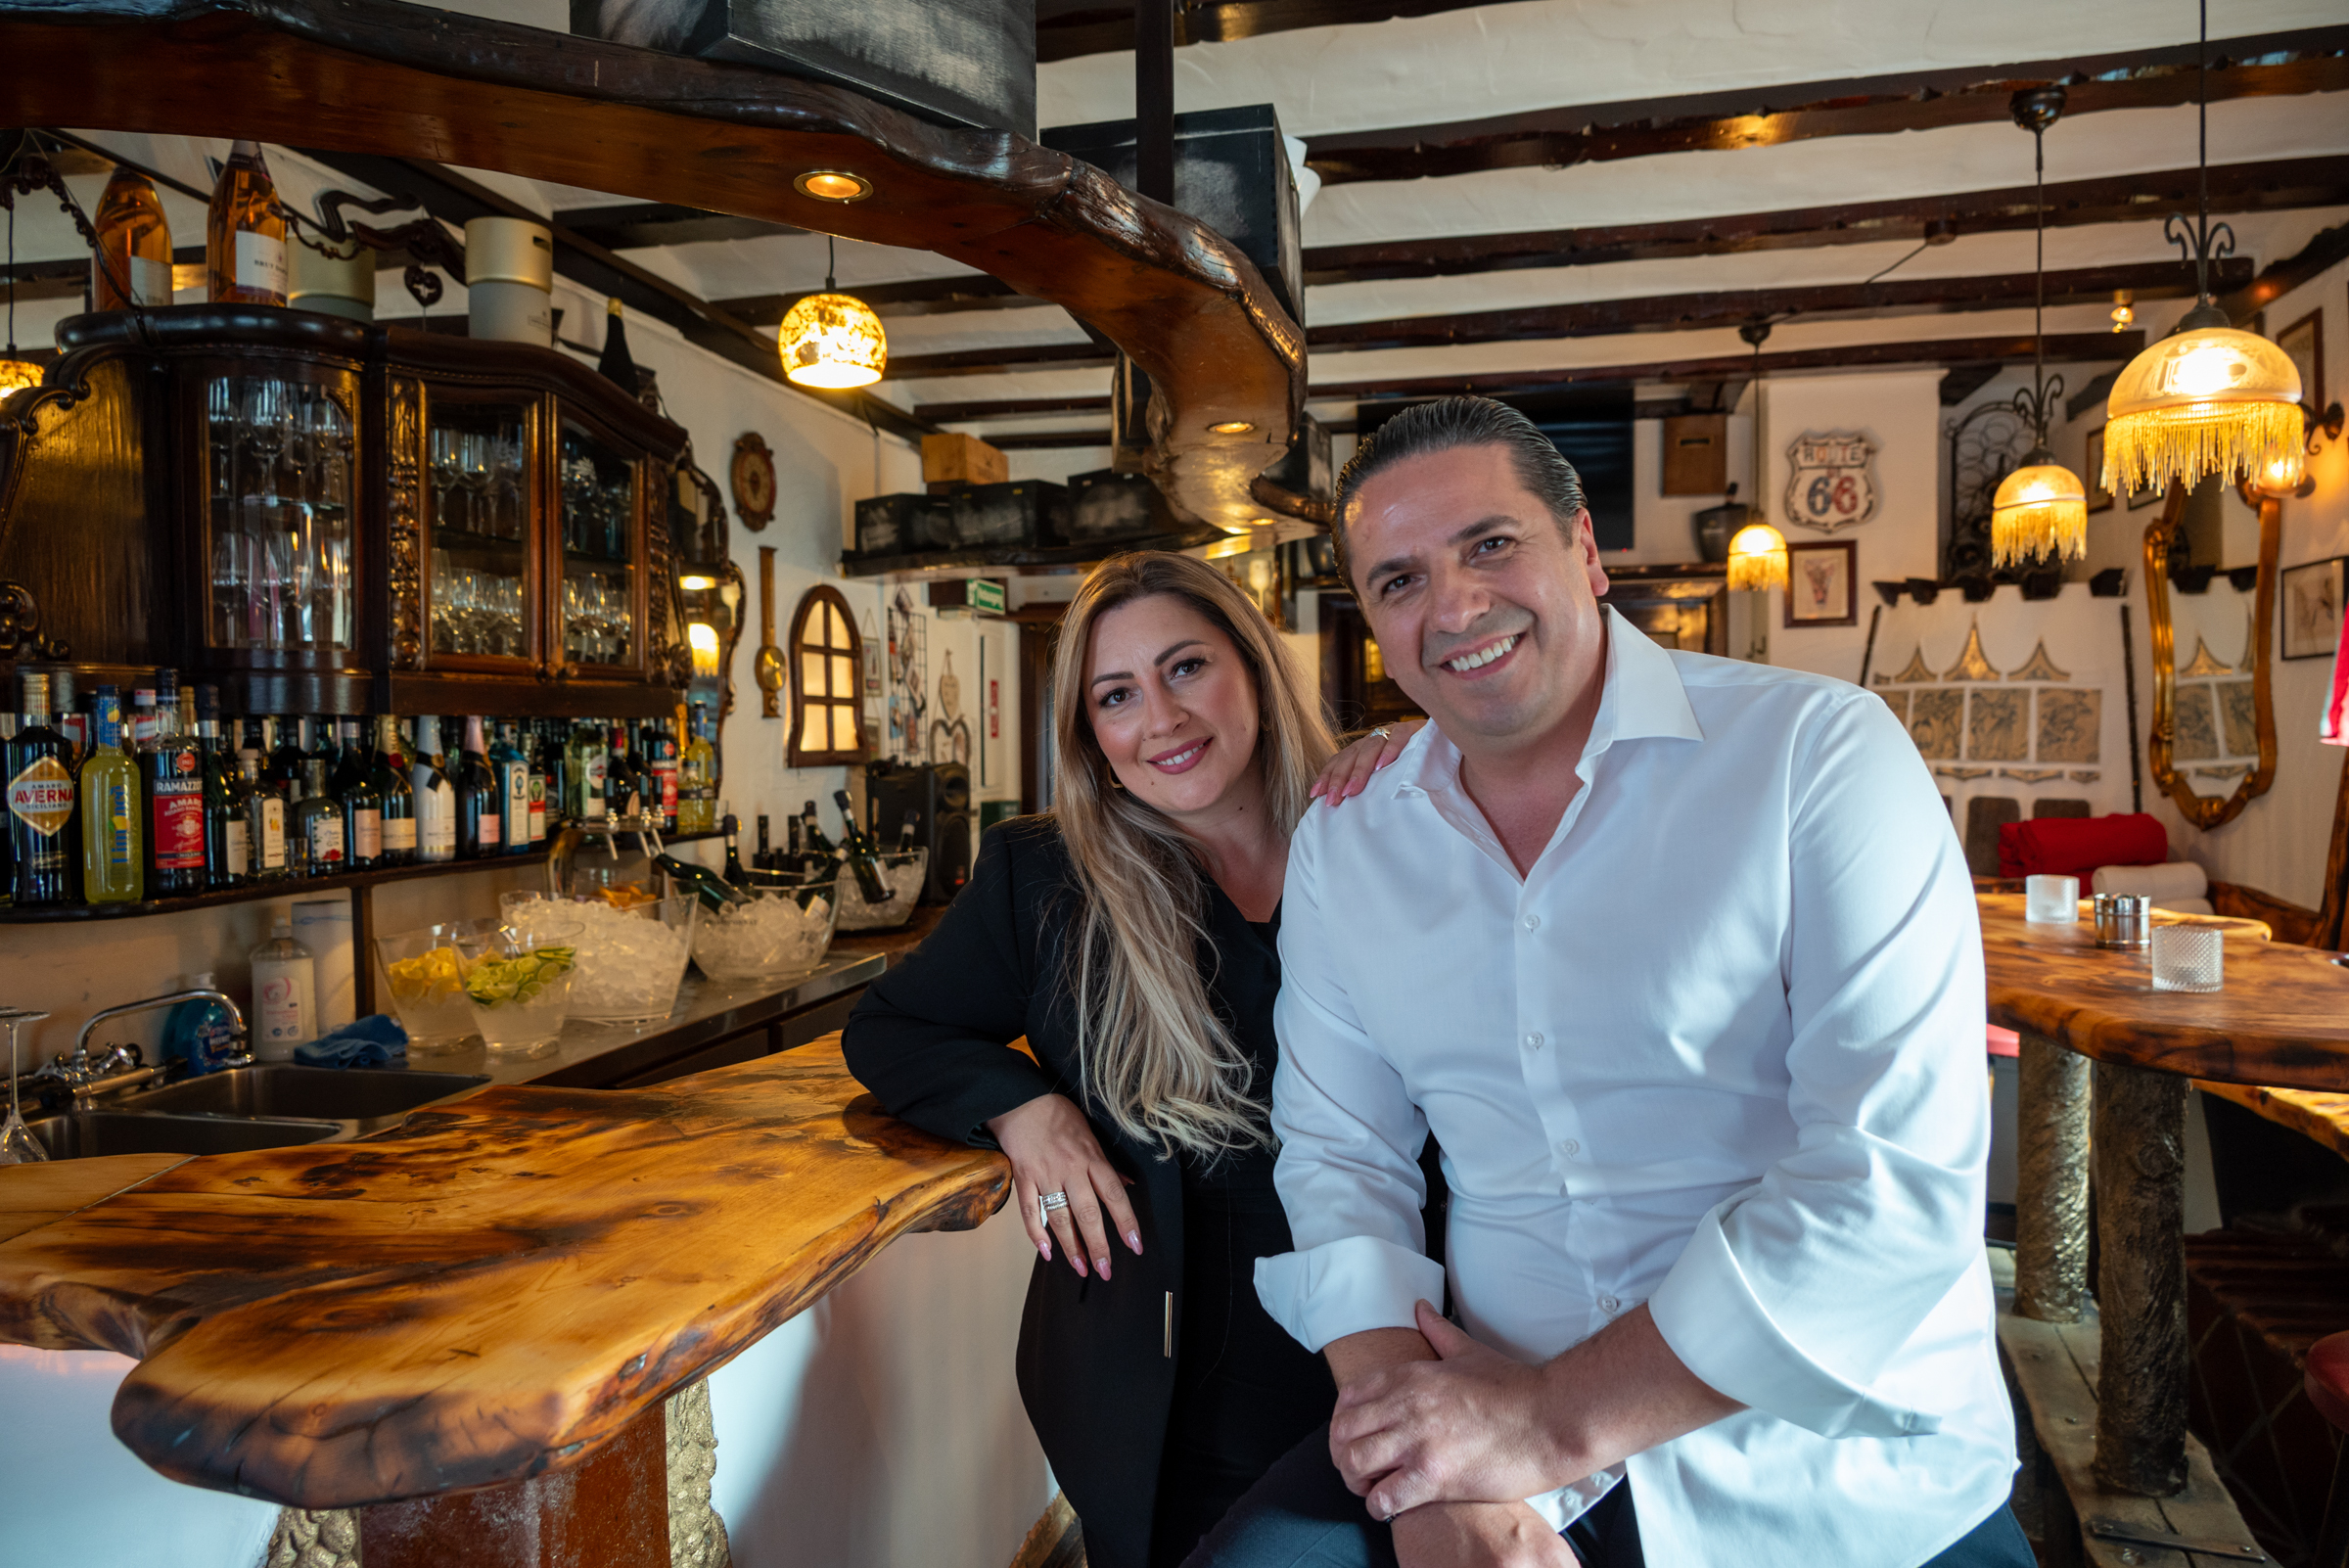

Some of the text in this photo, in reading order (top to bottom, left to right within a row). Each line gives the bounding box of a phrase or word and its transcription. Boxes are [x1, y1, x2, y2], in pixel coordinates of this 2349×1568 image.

[1804, 445, 1861, 463] ROUTE
[1808, 477, 1858, 516] 66
[15, 788, 73, 804] AVERNA
